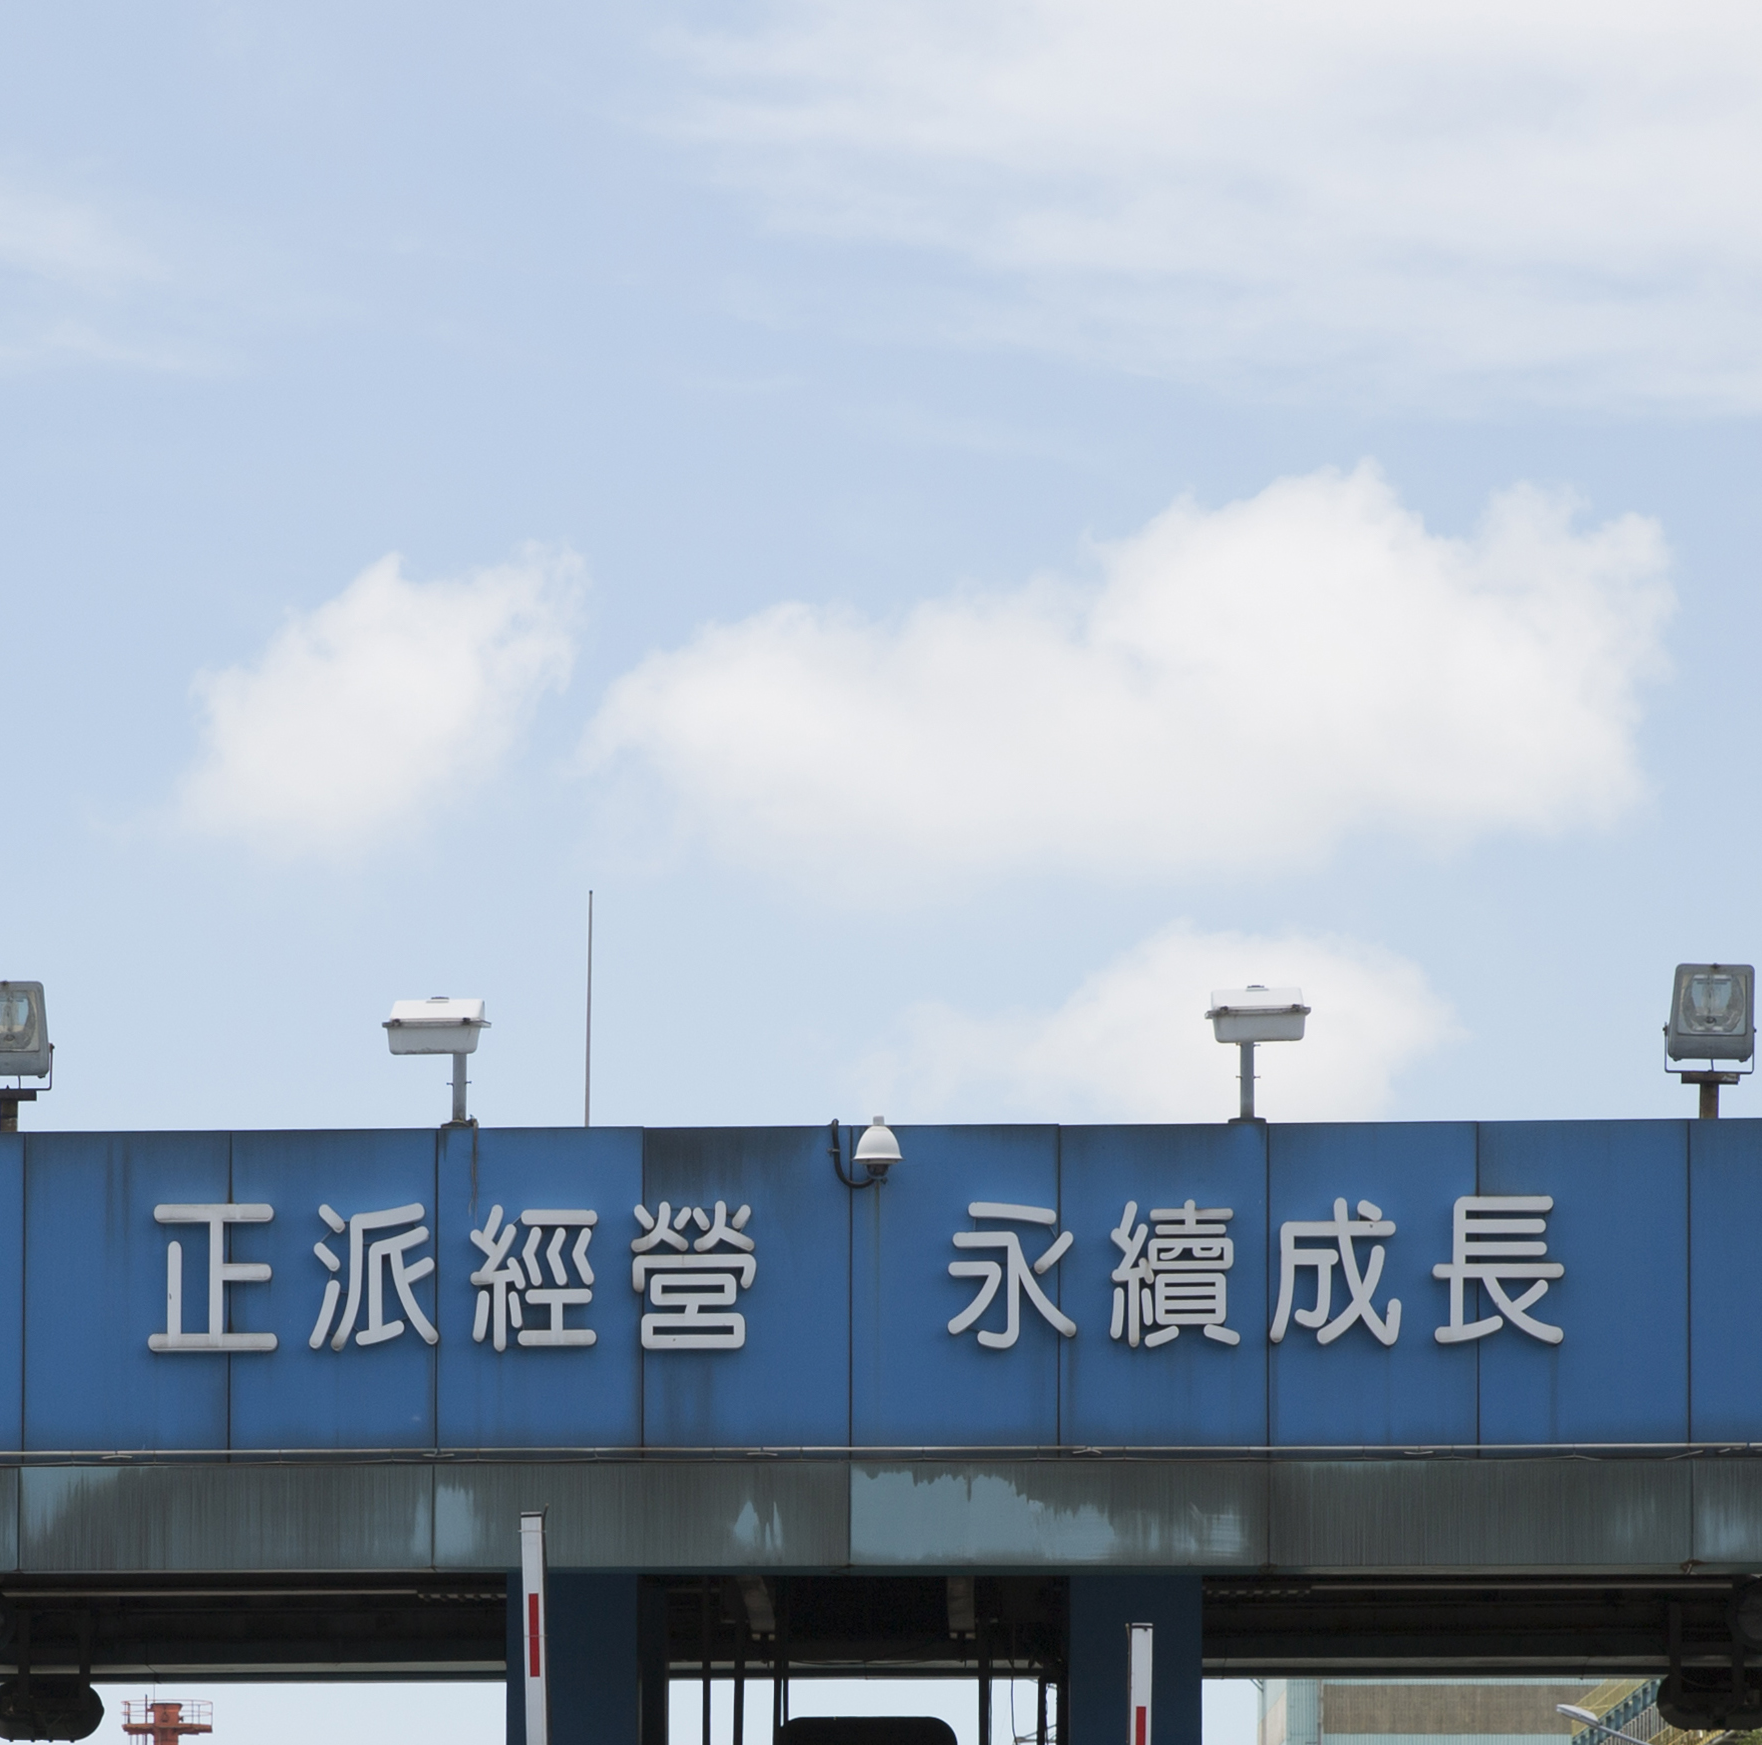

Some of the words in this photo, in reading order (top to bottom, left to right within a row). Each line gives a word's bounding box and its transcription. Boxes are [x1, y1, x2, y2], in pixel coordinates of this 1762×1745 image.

[148, 1200, 756, 1352] 正派經營
[946, 1197, 1565, 1350] 永續成長
